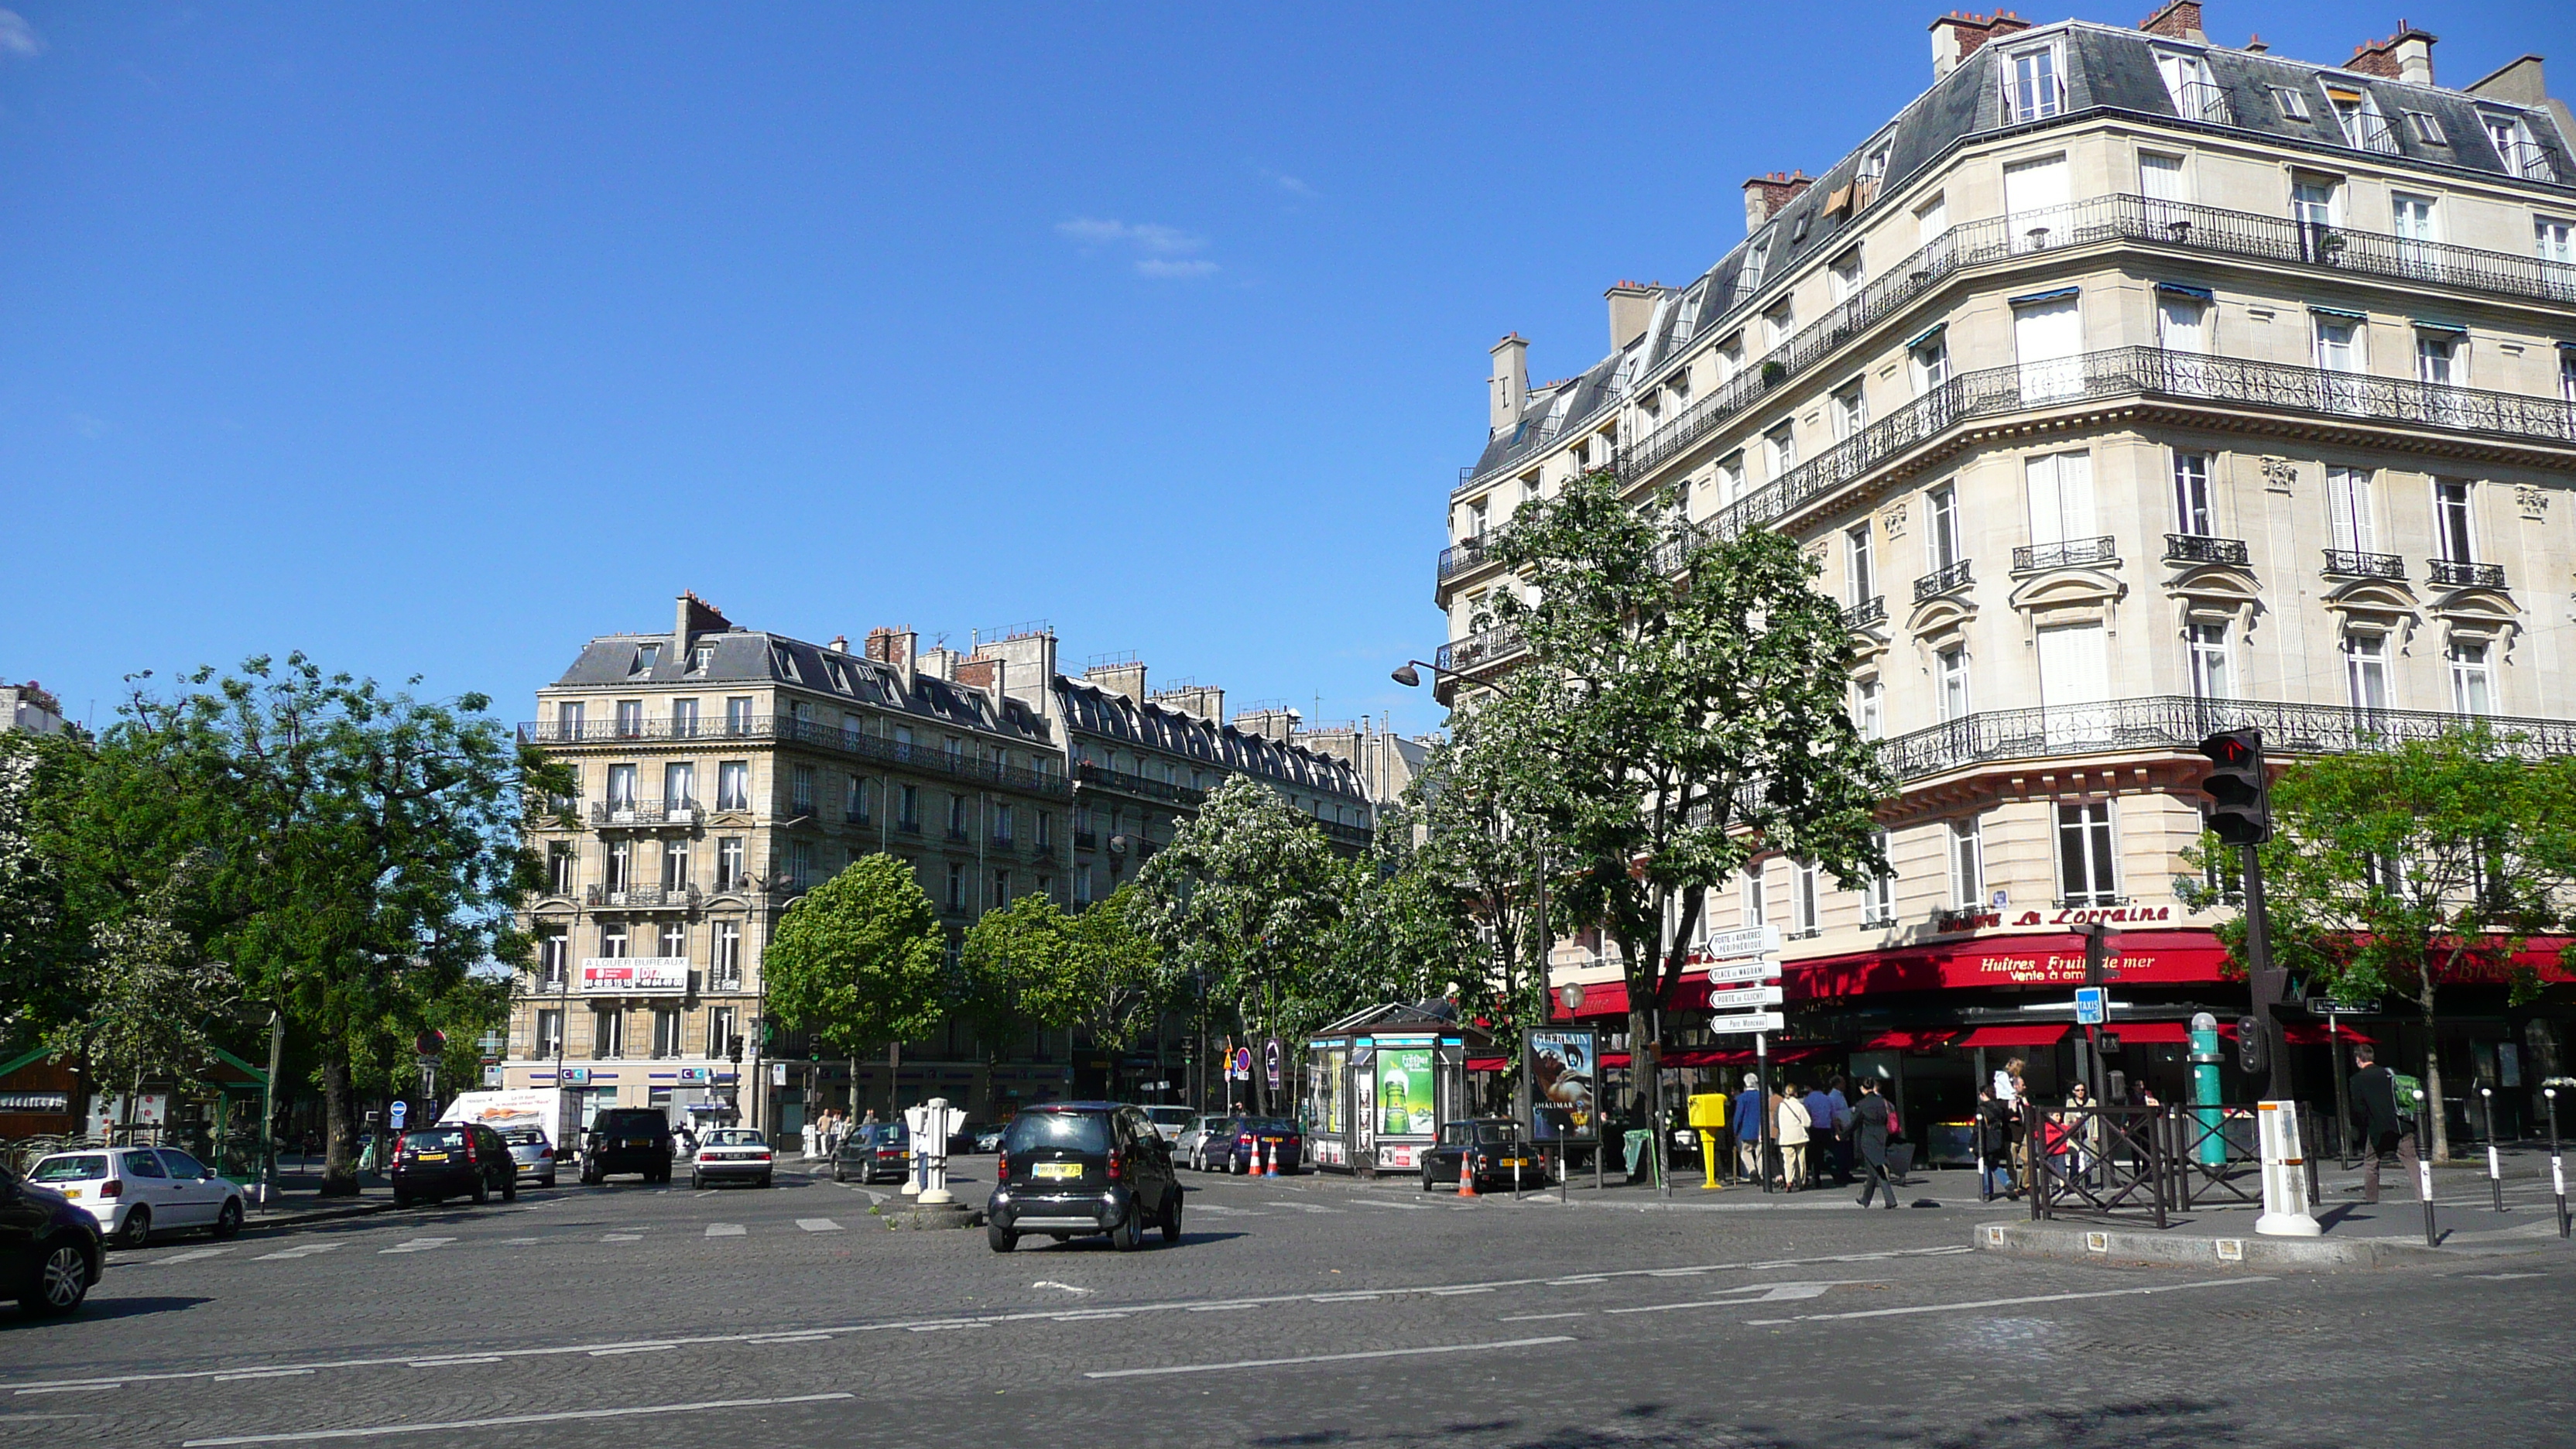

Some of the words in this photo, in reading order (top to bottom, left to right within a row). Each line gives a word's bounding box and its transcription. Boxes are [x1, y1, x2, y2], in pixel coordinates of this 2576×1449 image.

[2049, 900, 2169, 925] Lorraine
[1714, 936, 1731, 944] PORTE
[1719, 940, 1762, 953] PÉRIPHÉRIQUE
[635, 958, 685, 967] BUREAUX
[1981, 957, 2036, 972] Huîtres
[2123, 956, 2155, 968] mer
[1714, 970, 1731, 978] PLACE
[1738, 966, 1762, 976] WAGRAM
[2010, 971, 2045, 981] Vente
[2049, 969, 2058, 980] à
[1743, 992, 1763, 1001] CLICHY
[2078, 1000, 2100, 1011] TAXIS
[1729, 1019, 1741, 1028] Parc
[1742, 1019, 1765, 1027] Monceau
[1533, 1033, 1588, 1045] GUERLAIN
[563, 1070, 581, 1079] CIC
[683, 1068, 704, 1079] CIC
